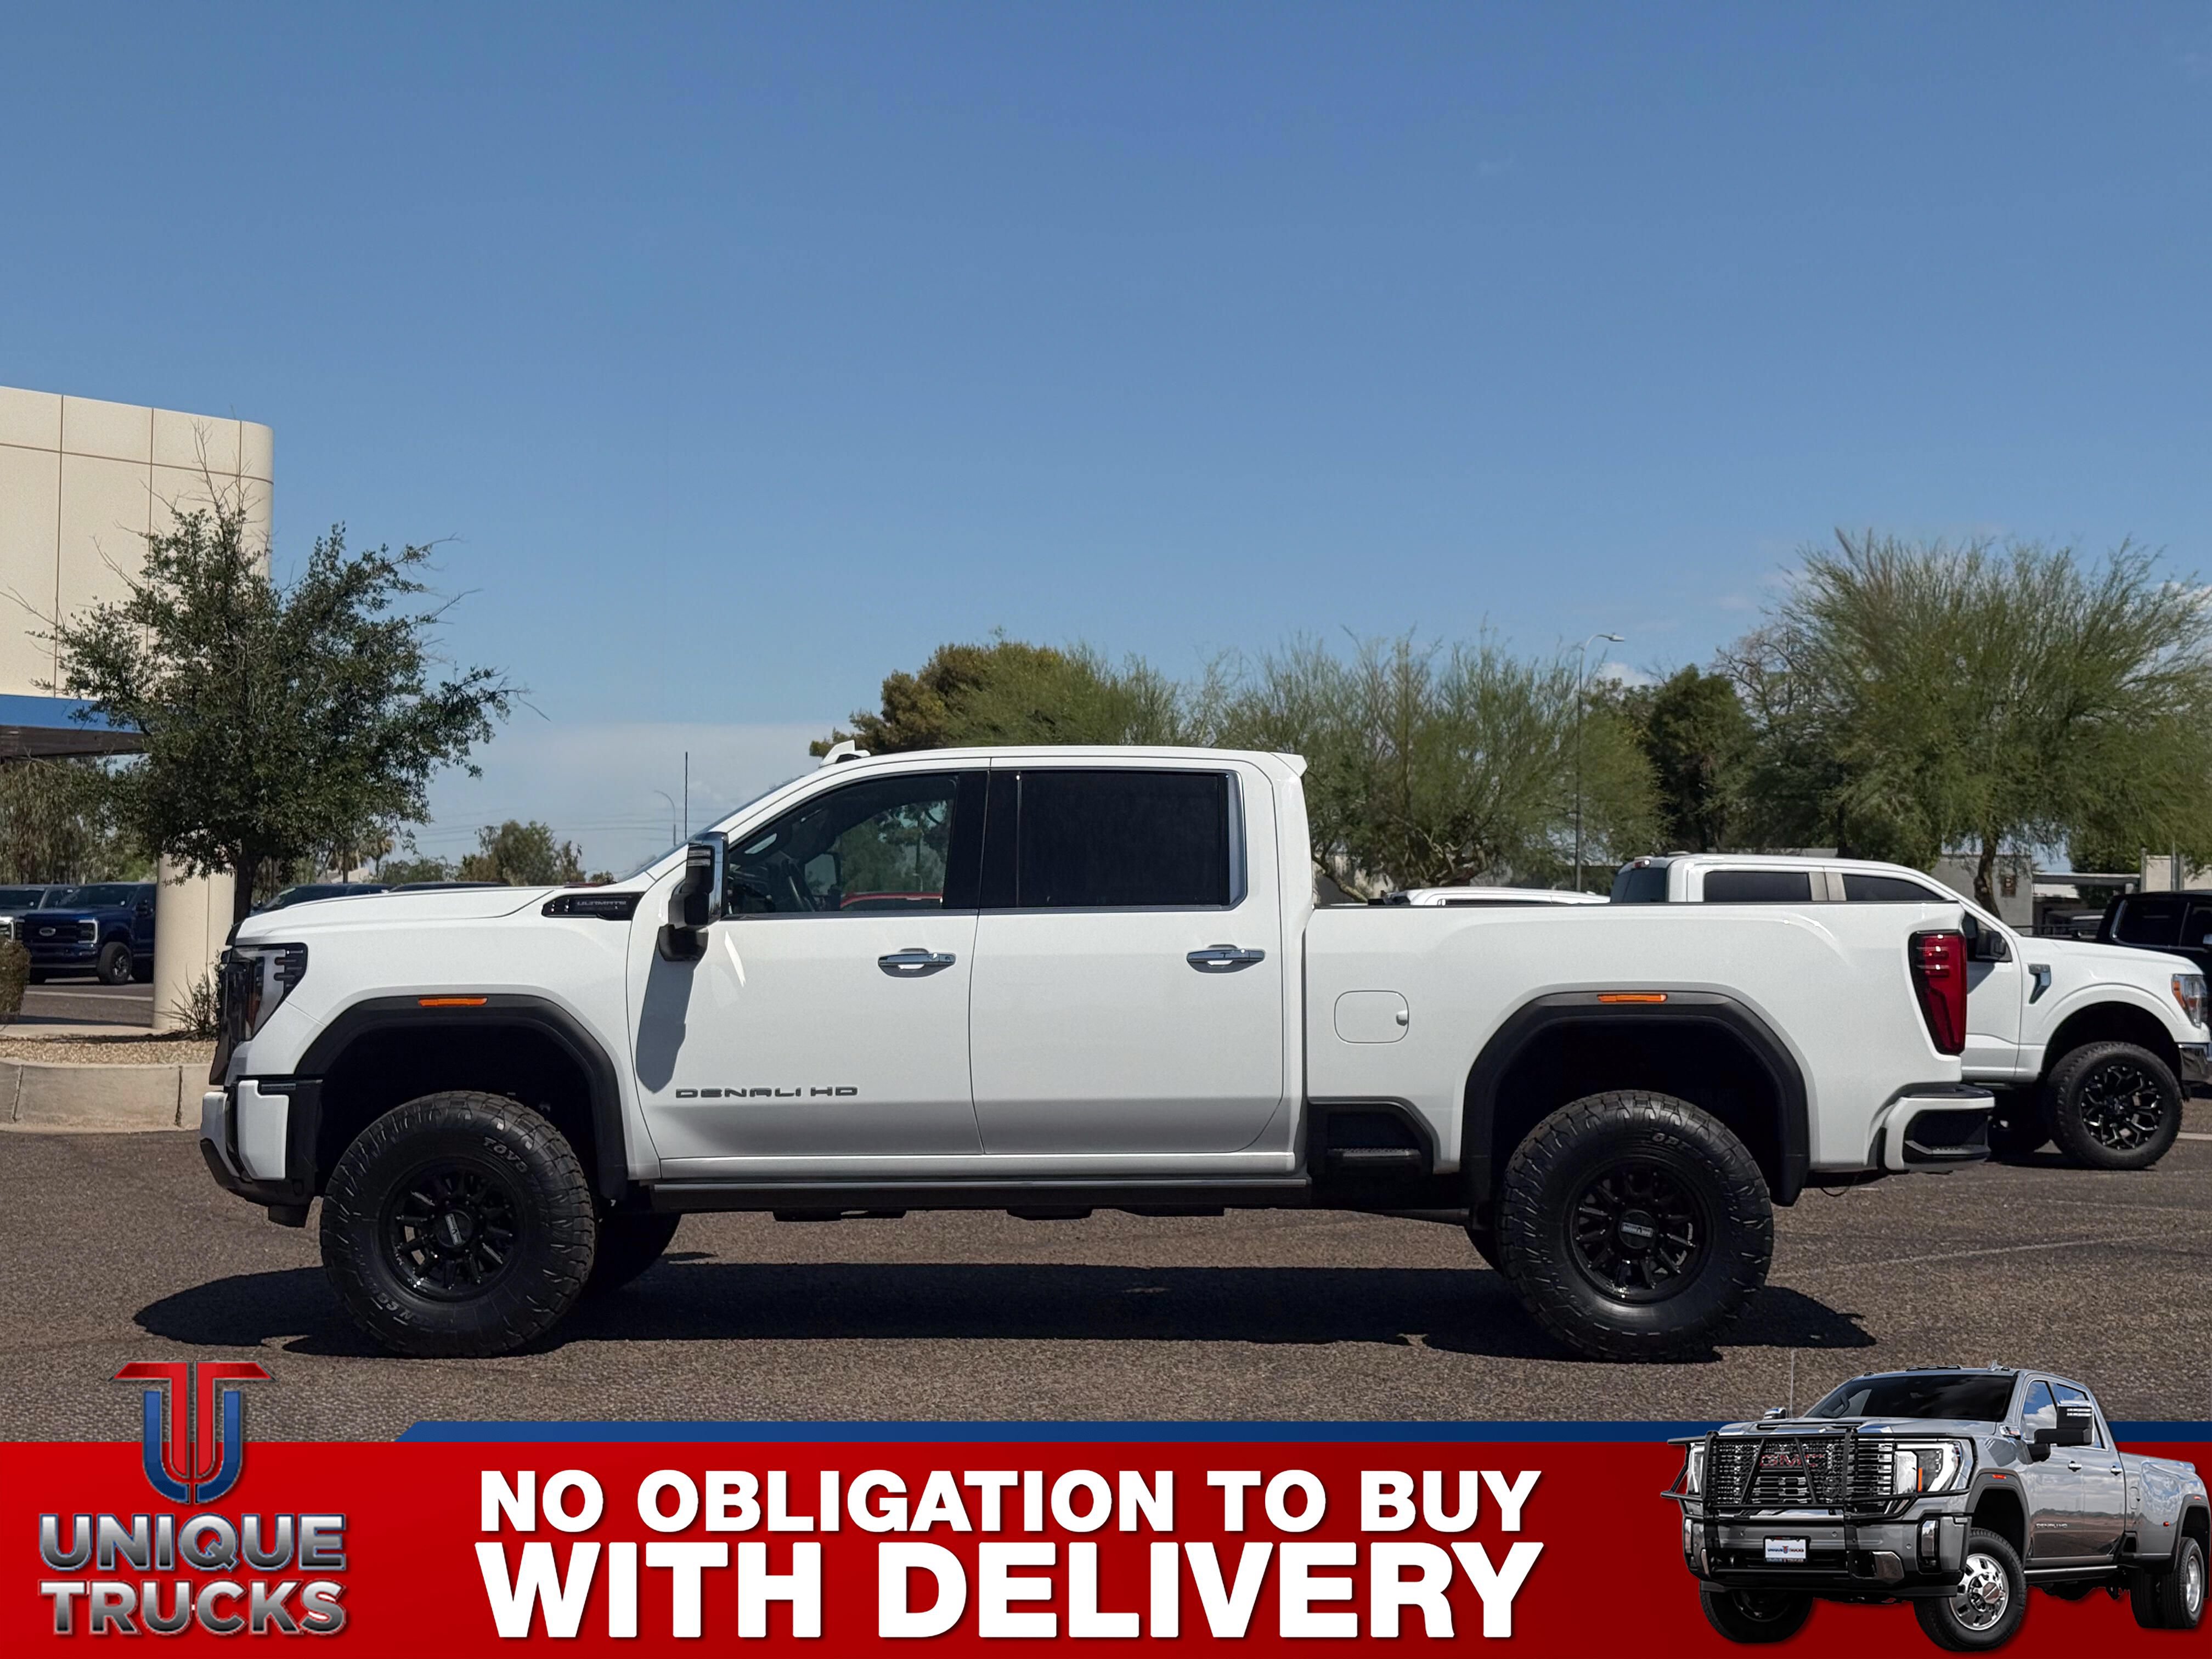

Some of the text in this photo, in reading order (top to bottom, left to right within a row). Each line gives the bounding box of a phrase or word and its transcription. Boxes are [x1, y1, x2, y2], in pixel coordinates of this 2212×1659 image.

[676, 1086, 858, 1098] DENALI HD
[484, 1136, 528, 1172] TOYO
